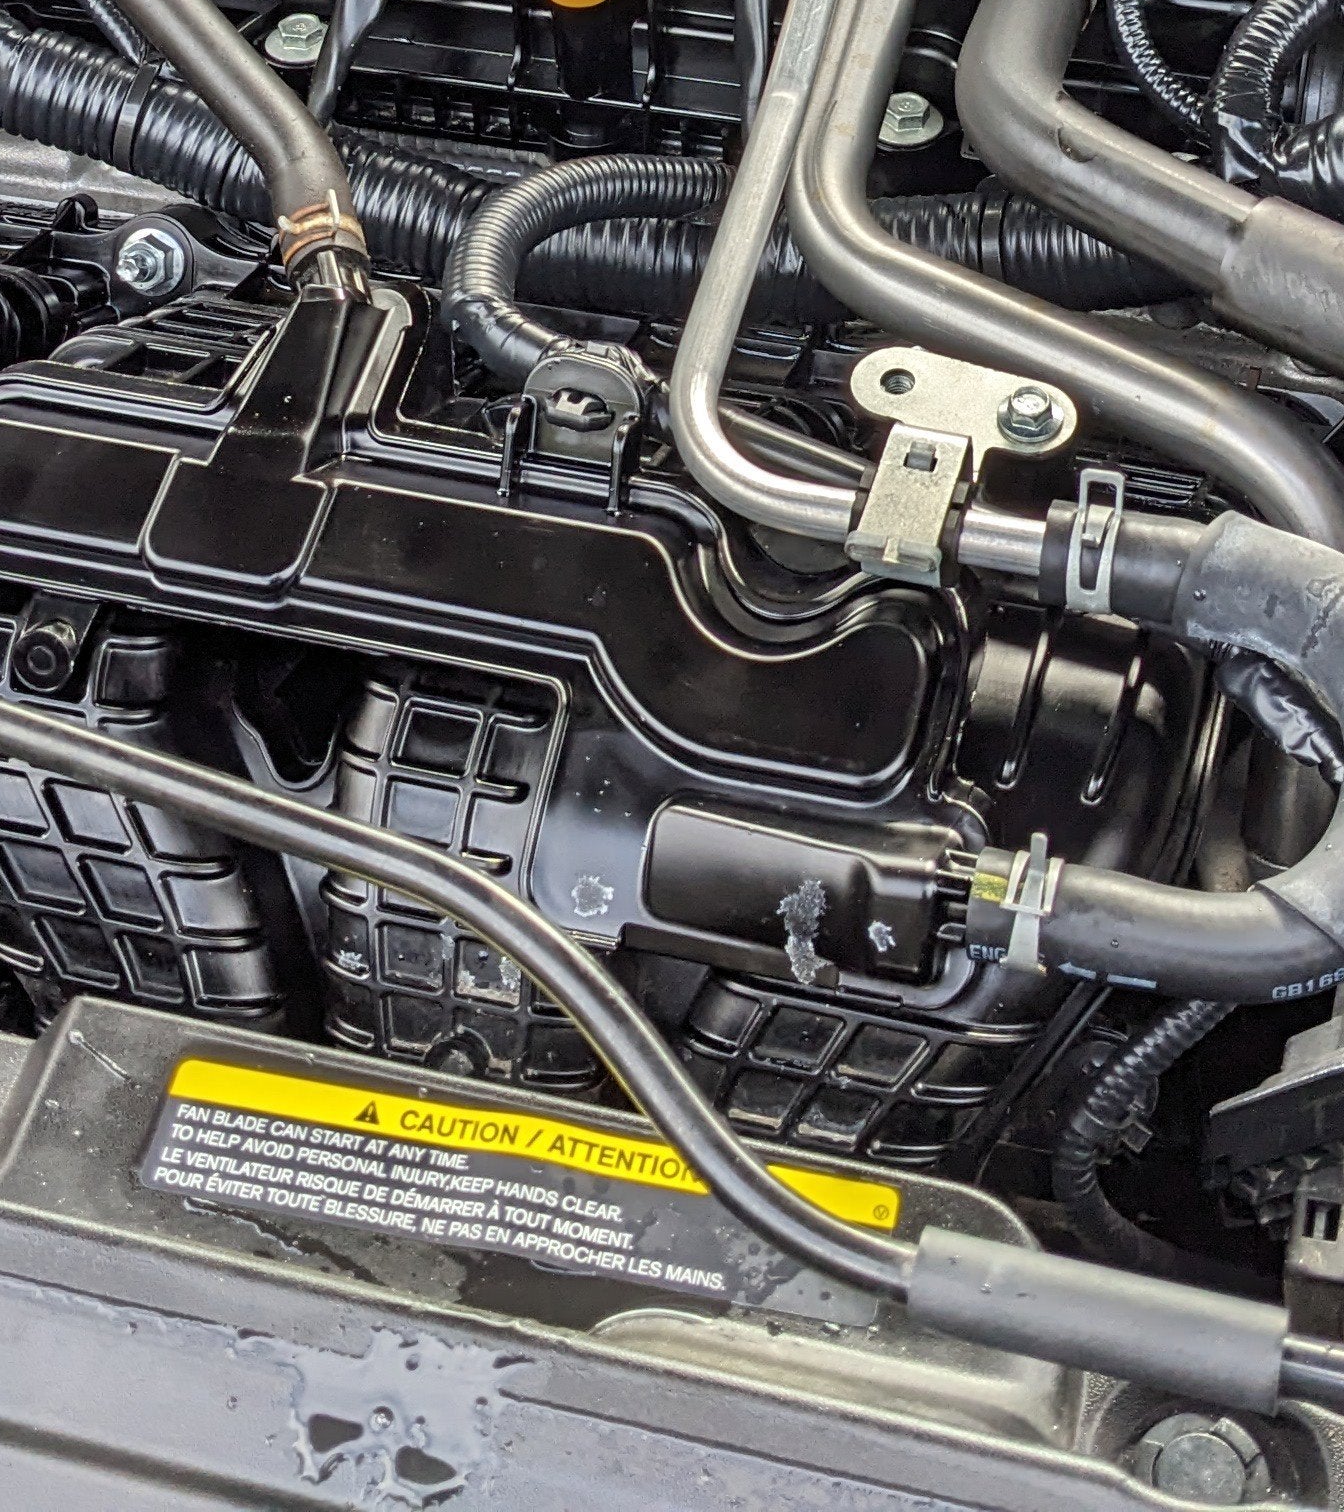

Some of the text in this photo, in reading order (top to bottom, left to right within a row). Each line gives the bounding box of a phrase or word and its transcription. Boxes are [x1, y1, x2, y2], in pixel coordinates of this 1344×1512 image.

[170, 1123, 194, 1140] TO
[195, 1130, 241, 1150] HELP
[241, 1137, 295, 1160] AVOID
[295, 1146, 388, 1179] PERSONAL
[496, 1181, 559, 1208] HANDS
[561, 1195, 624, 1223] CLEAR.
[177, 1104, 469, 1171] FAN BLADE CAN START AT ANY TIME.
[400, 1110, 519, 1145] CAUTION
[526, 1129, 543, 1148] /
[153, 1166, 726, 1292] POUR ÉVITER TOUTE BLESSURE, NE PAS EN APPROCHER LES MAINS.
[160, 1146, 634, 1251] LE VENTILATEUR RISQUE DE DÉMARRER À TOUT MOMENT.
